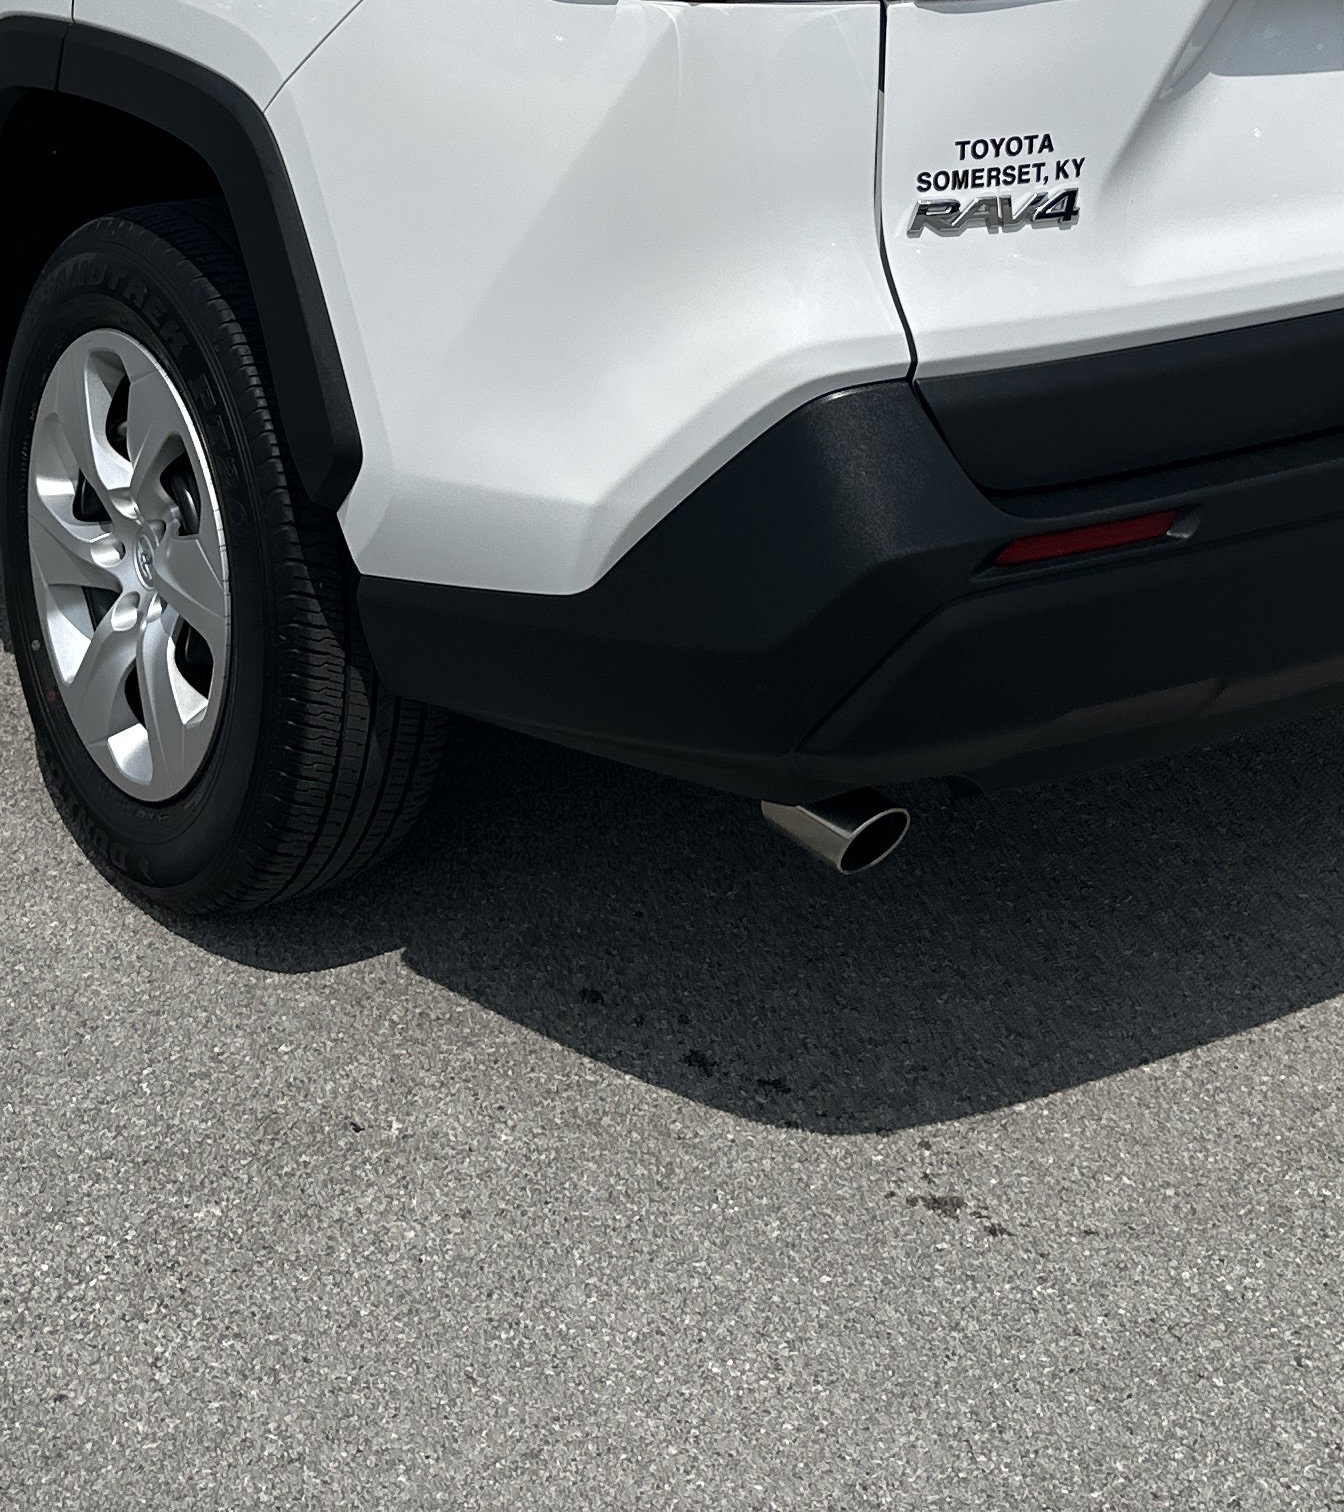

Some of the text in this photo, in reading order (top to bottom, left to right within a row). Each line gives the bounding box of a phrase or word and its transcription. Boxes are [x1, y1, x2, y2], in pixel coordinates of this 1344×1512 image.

[955, 133, 1055, 161] TOYOTA
[916, 157, 1086, 193] SOMERSET, KY
[906, 187, 1081, 238] RAV4
